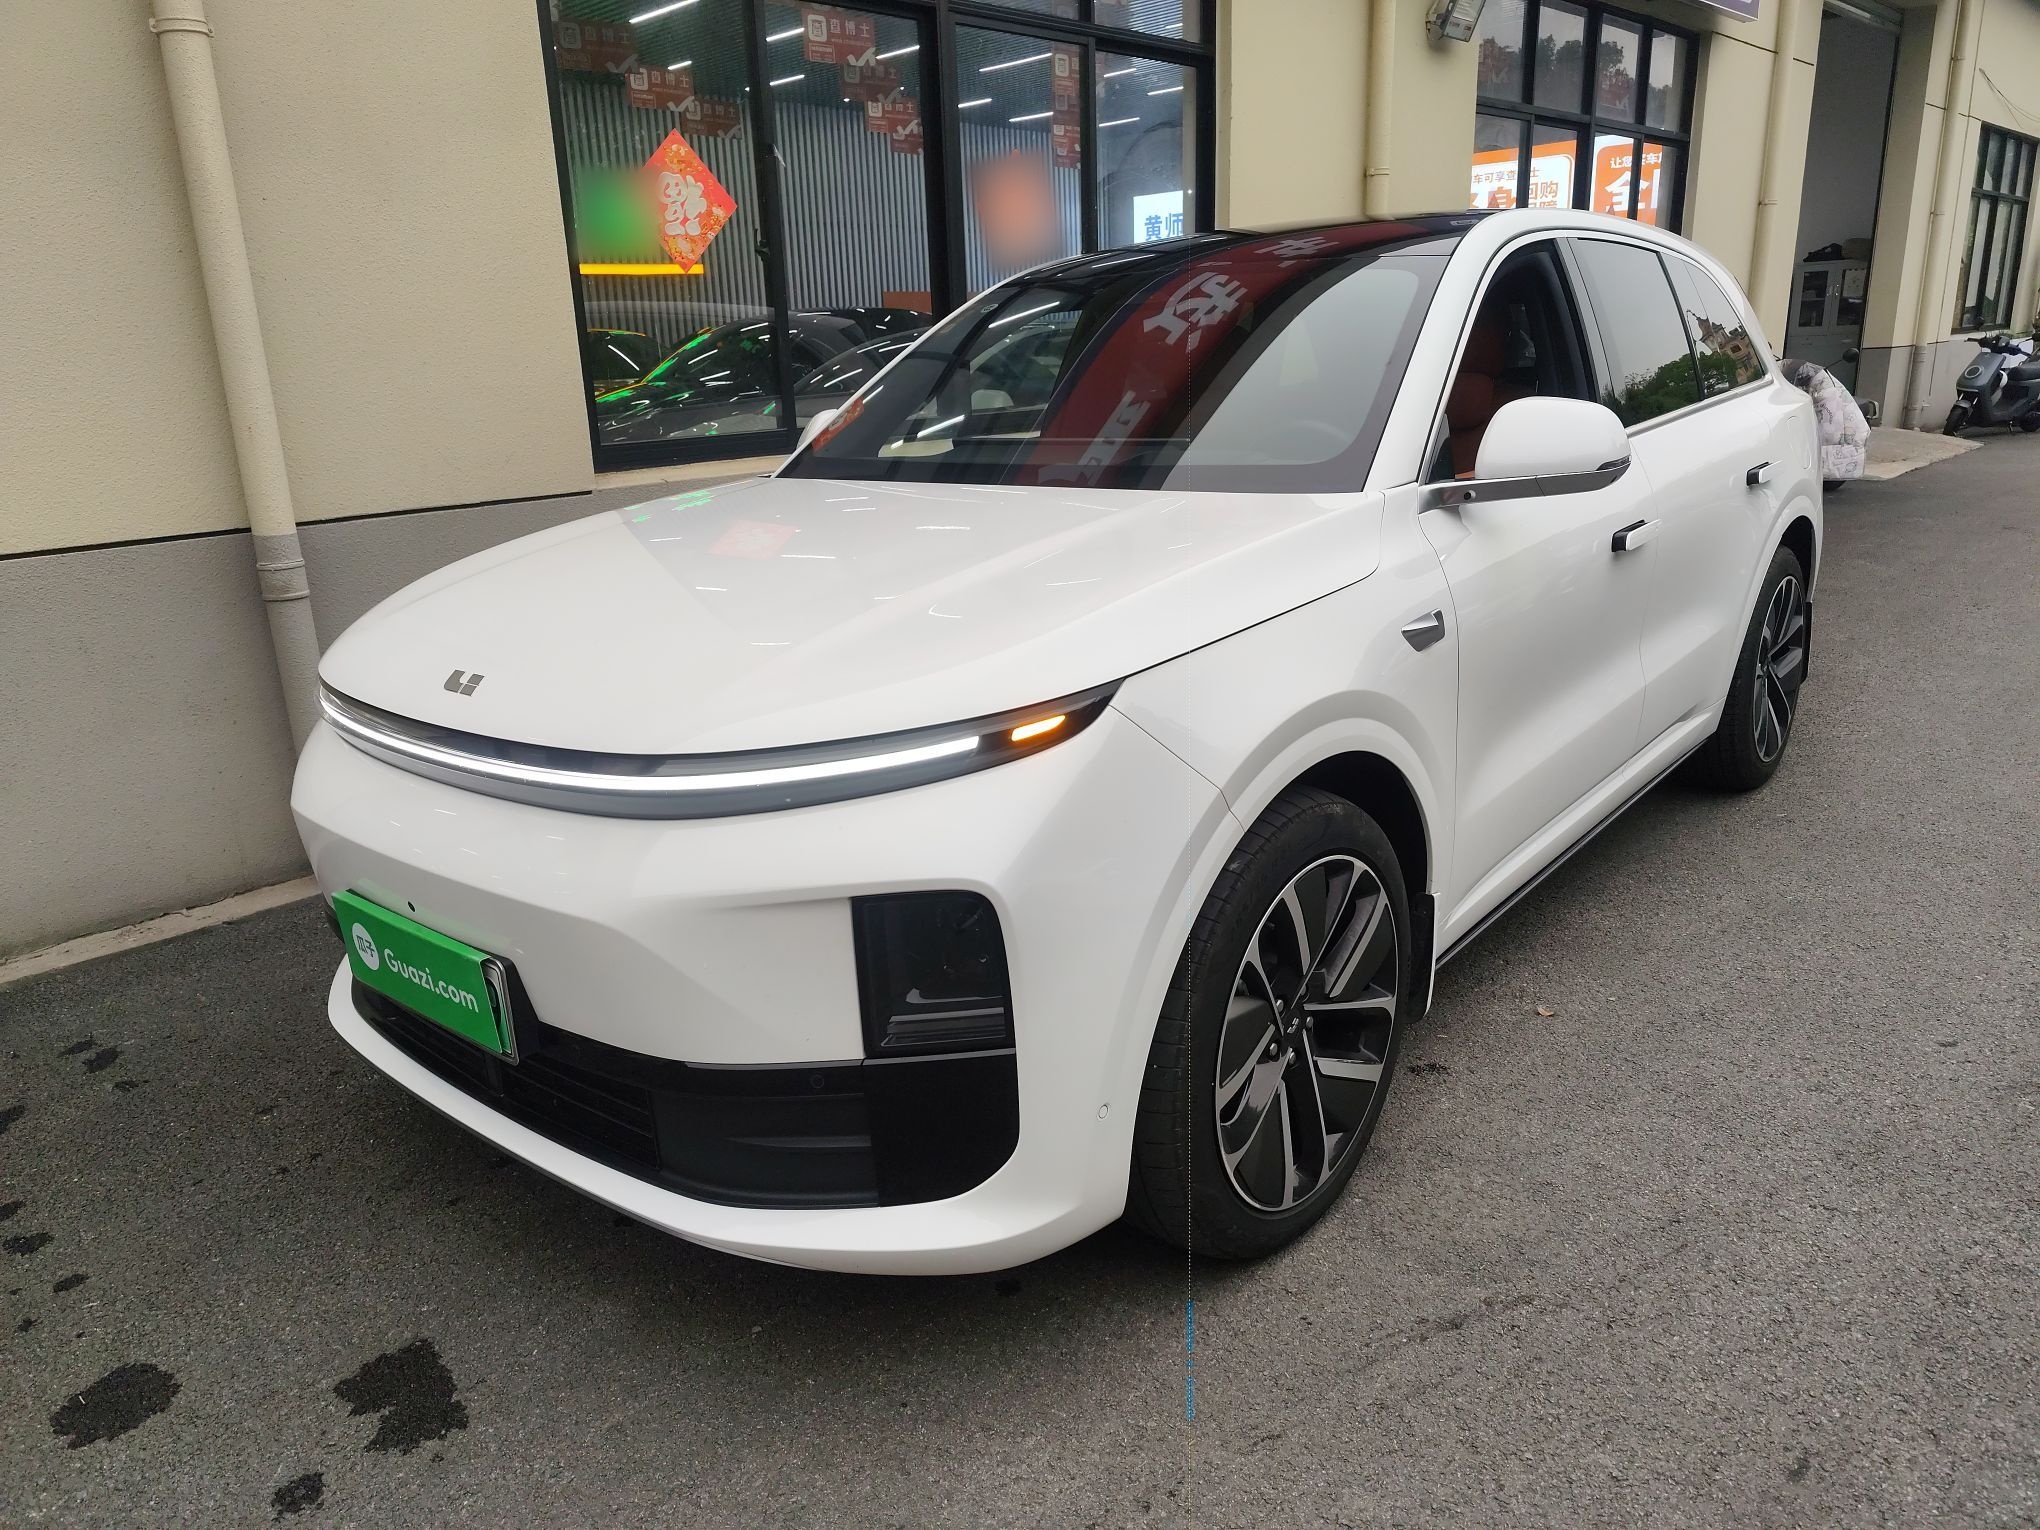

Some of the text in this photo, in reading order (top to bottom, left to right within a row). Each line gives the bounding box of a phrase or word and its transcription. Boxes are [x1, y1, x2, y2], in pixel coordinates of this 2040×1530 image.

[830, 18, 870, 38] 查博士
[1473, 166, 1540, 184] 车可享查士
[384, 948, 479, 1013] Guazi.com
